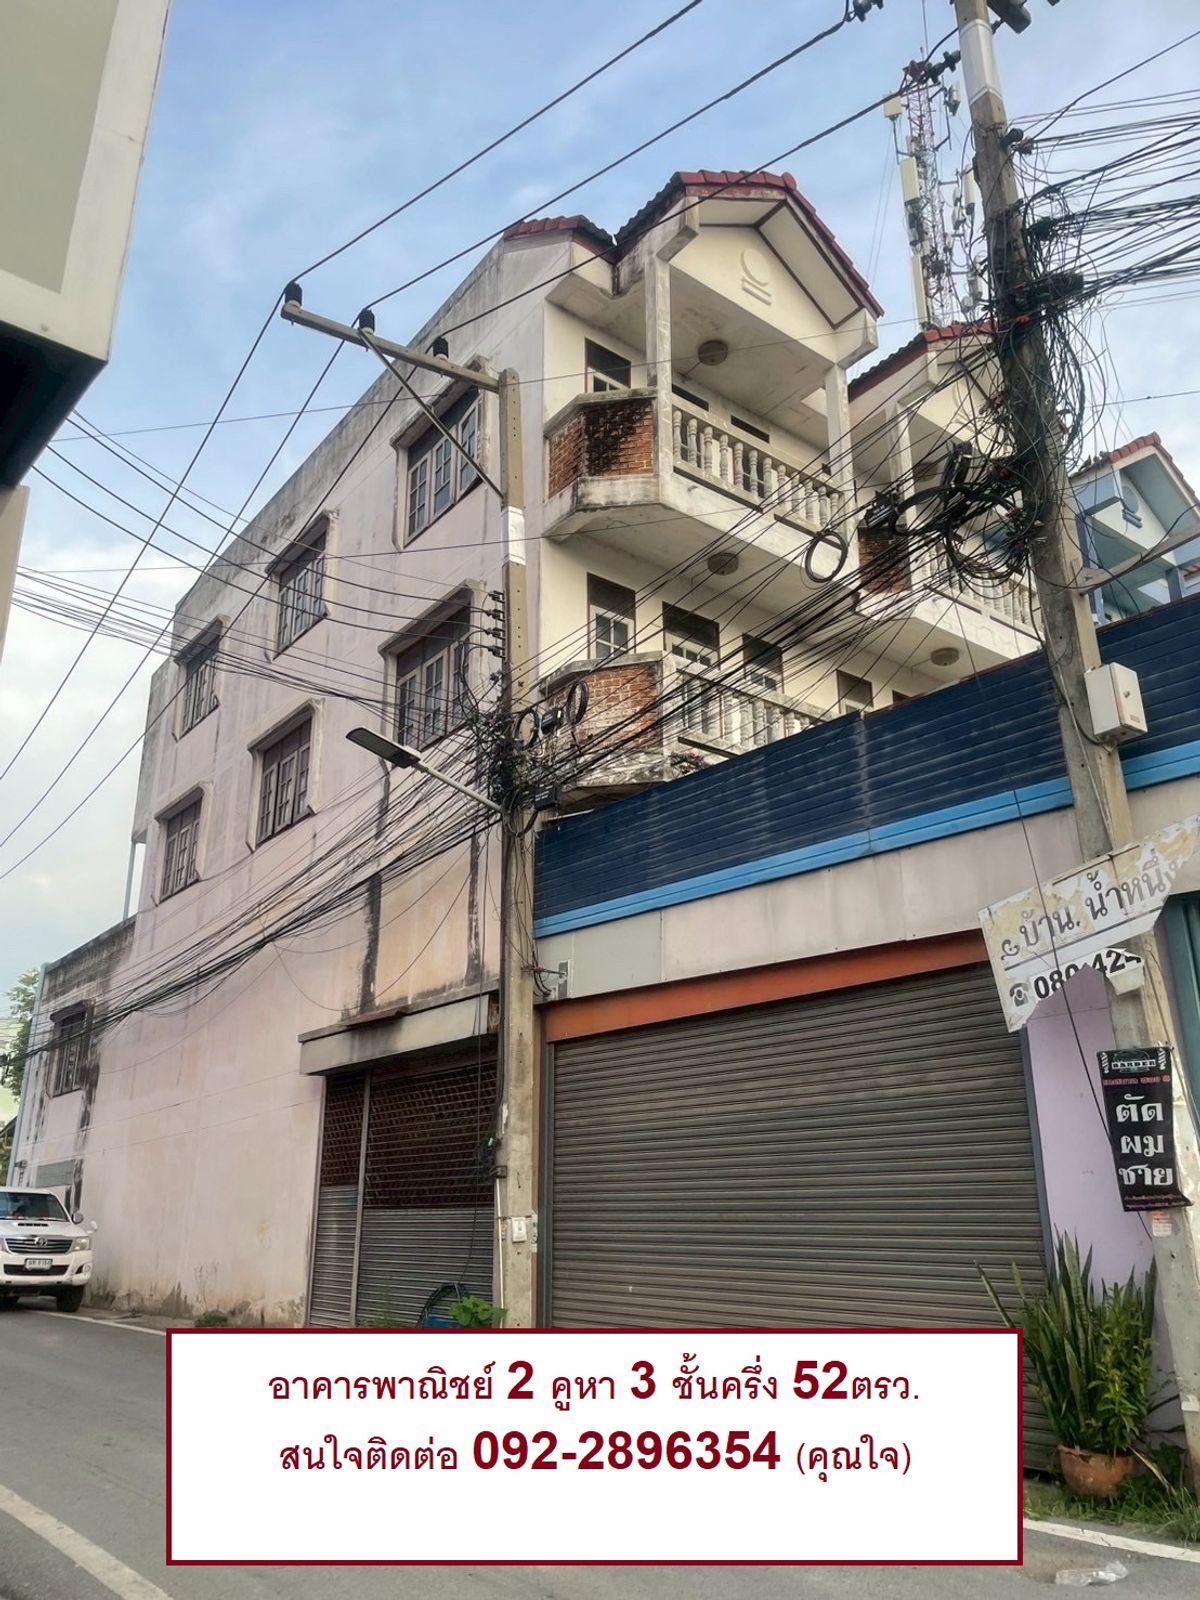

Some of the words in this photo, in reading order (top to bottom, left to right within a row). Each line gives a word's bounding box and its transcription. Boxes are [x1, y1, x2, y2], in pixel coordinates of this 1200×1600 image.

[1112, 1060, 1156, 1069] BARBER
[1115, 1093, 1164, 1123] ตัด
[1120, 1135, 1164, 1157] ผม
[1118, 1164, 1173, 1186] ชาย
